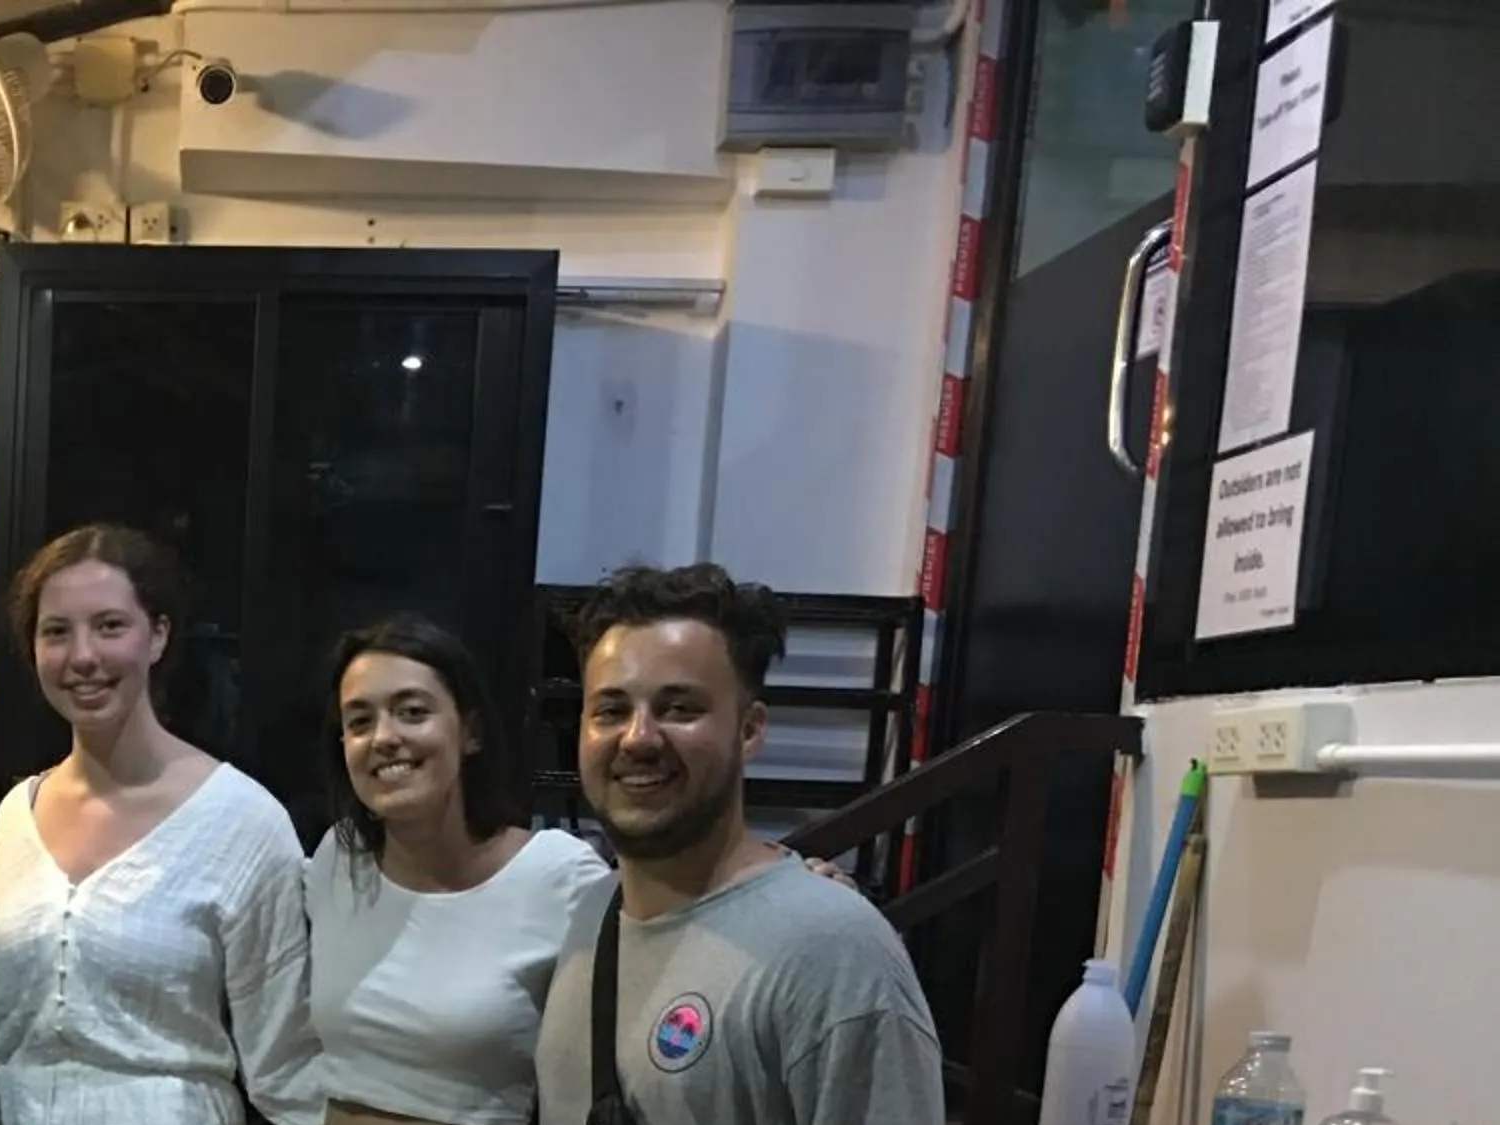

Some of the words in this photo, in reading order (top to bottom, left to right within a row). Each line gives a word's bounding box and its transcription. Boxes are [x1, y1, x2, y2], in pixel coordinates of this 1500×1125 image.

[1265, 466, 1282, 488] are
[1216, 512, 1253, 539] allowed
[1255, 510, 1266, 529] to
[1268, 505, 1294, 528] bring
